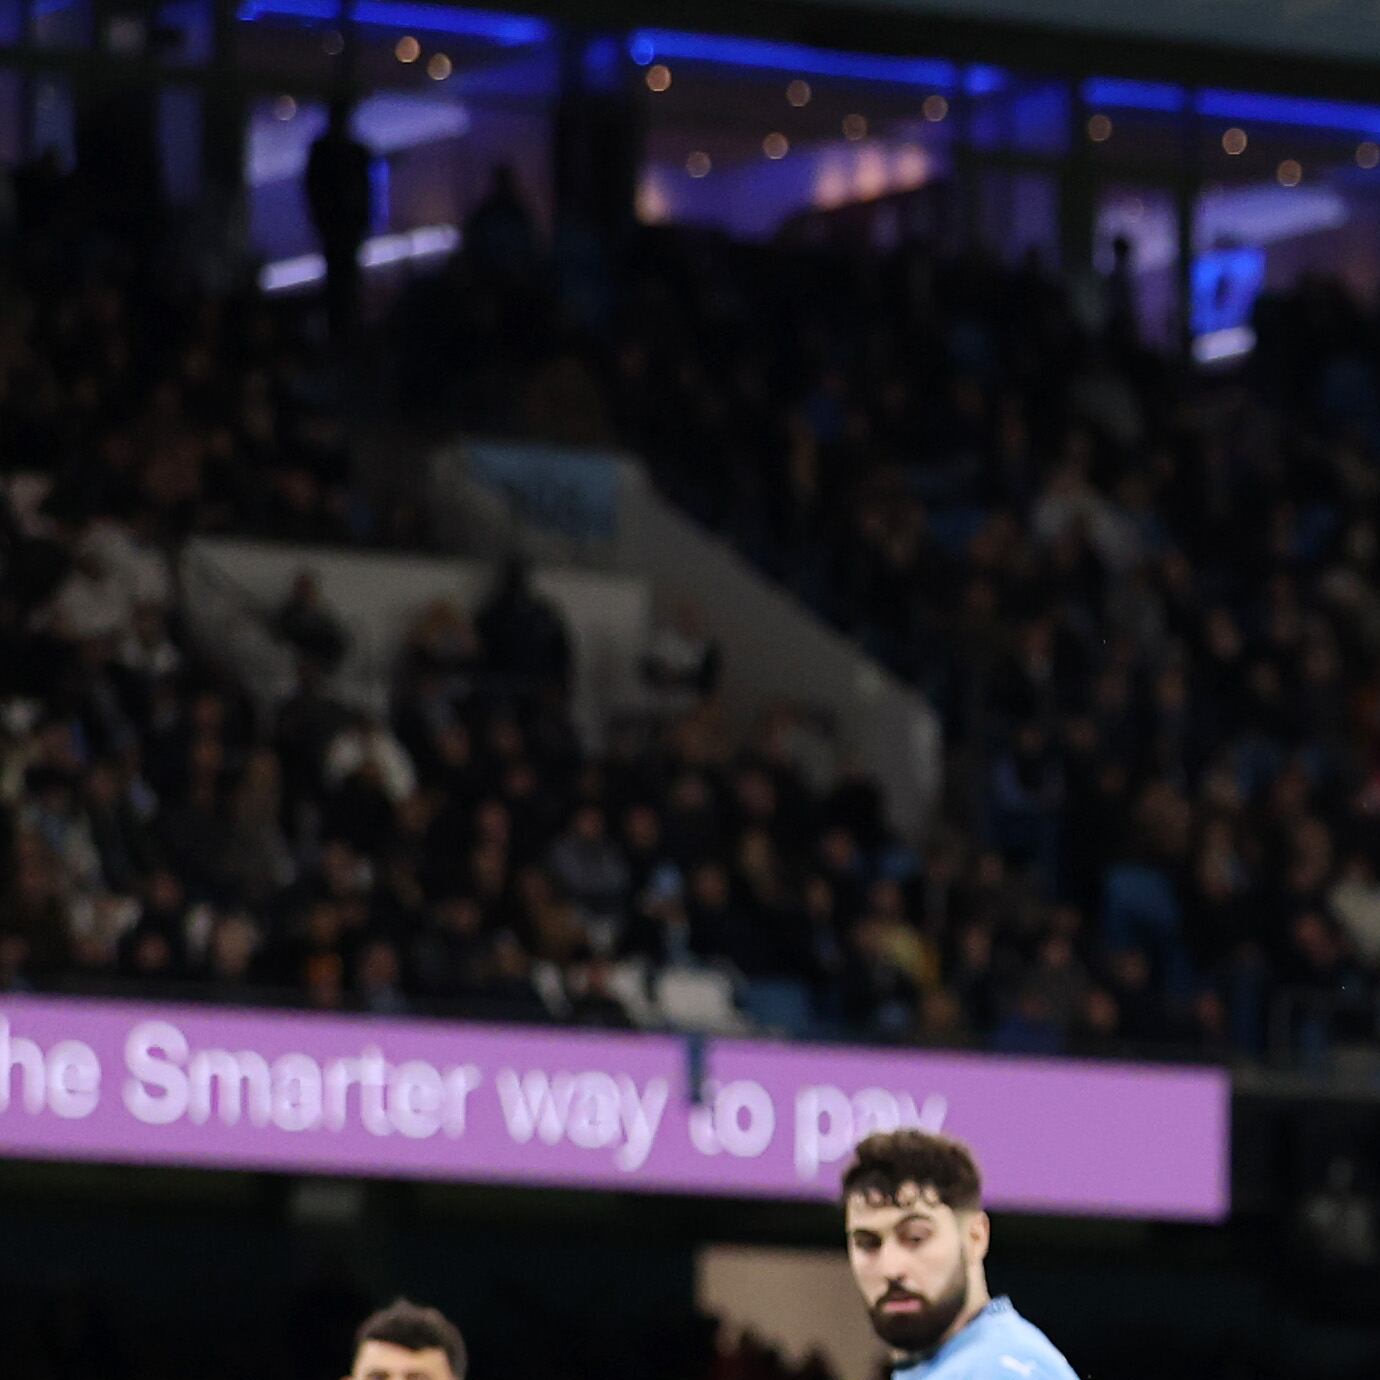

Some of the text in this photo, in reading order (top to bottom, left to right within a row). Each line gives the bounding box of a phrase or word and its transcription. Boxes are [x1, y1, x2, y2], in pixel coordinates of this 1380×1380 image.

[0, 1013, 101, 1120] he
[122, 1020, 483, 1140] Smarter
[495, 1069, 669, 1172] way
